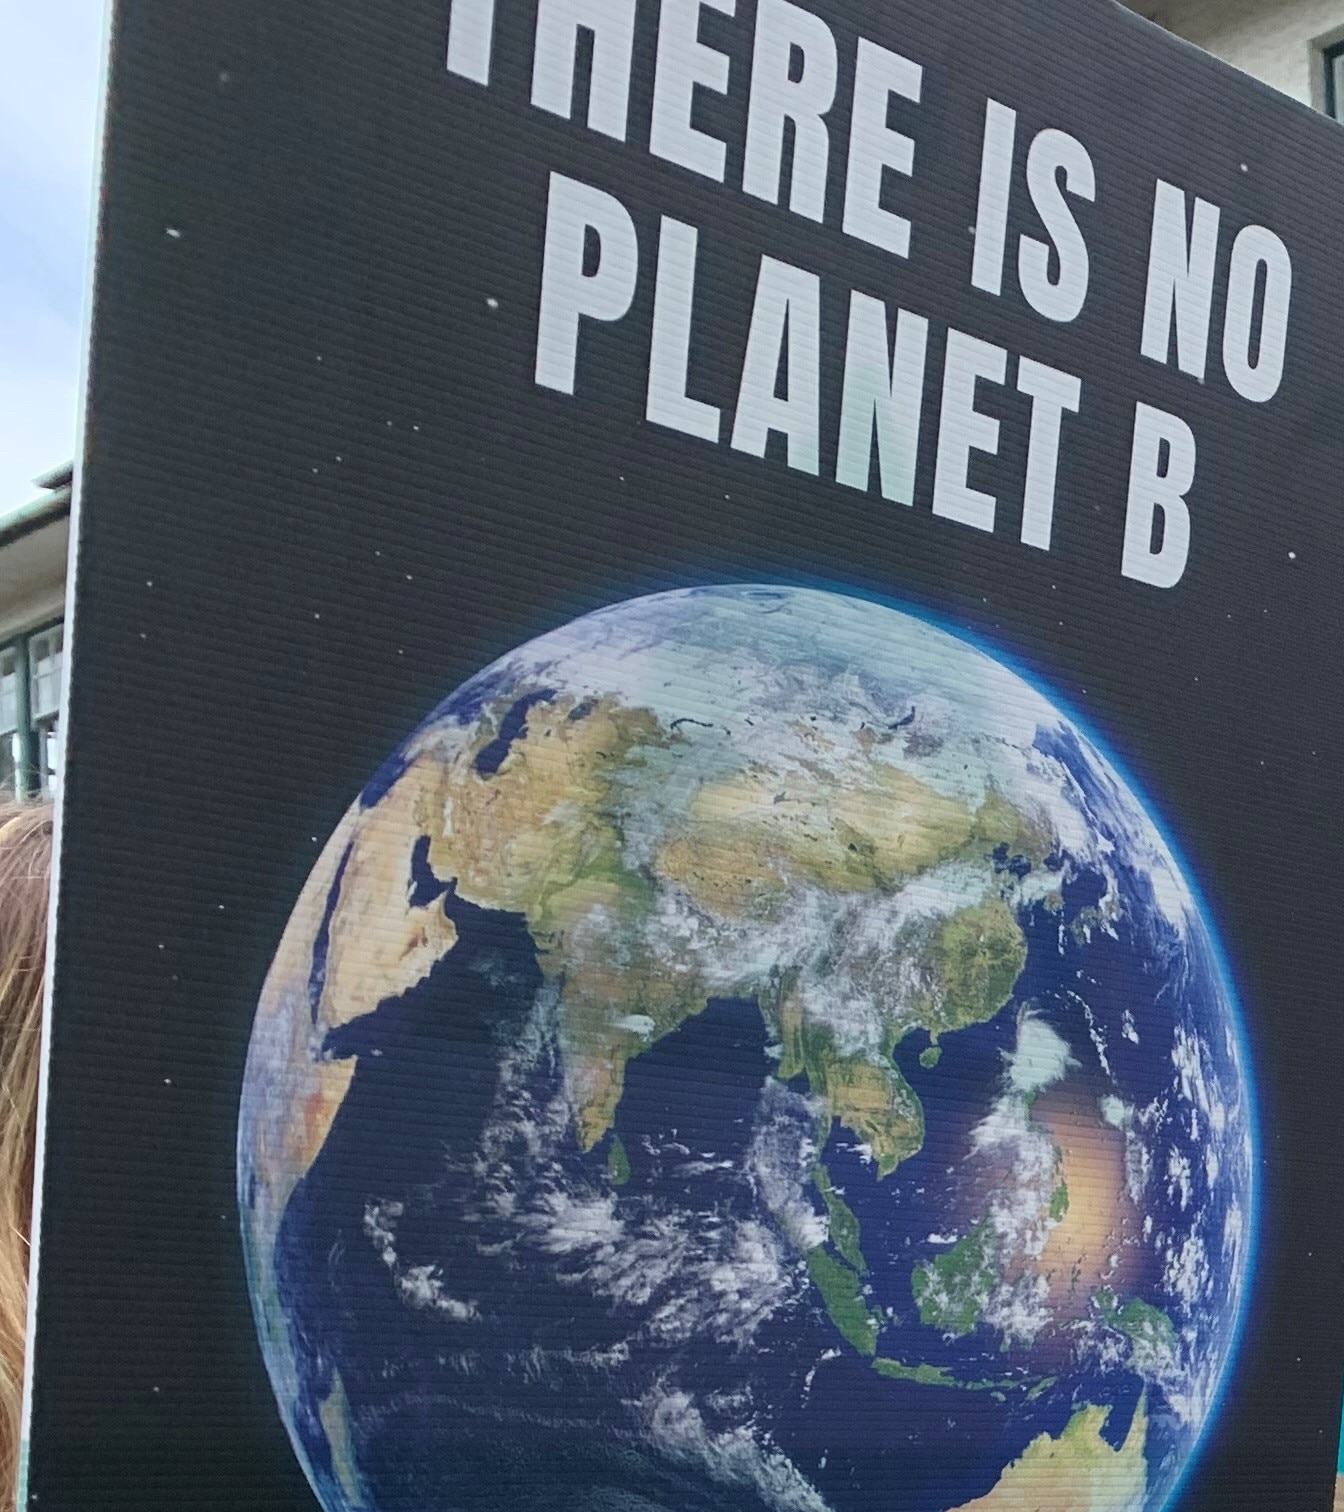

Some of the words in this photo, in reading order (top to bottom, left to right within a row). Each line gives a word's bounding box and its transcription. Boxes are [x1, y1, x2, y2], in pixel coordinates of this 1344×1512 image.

[534, 170, 1081, 552] PLANET
[1120, 401, 1198, 590] B
[970, 97, 1098, 325] IS
[1140, 176, 1293, 404] NO
